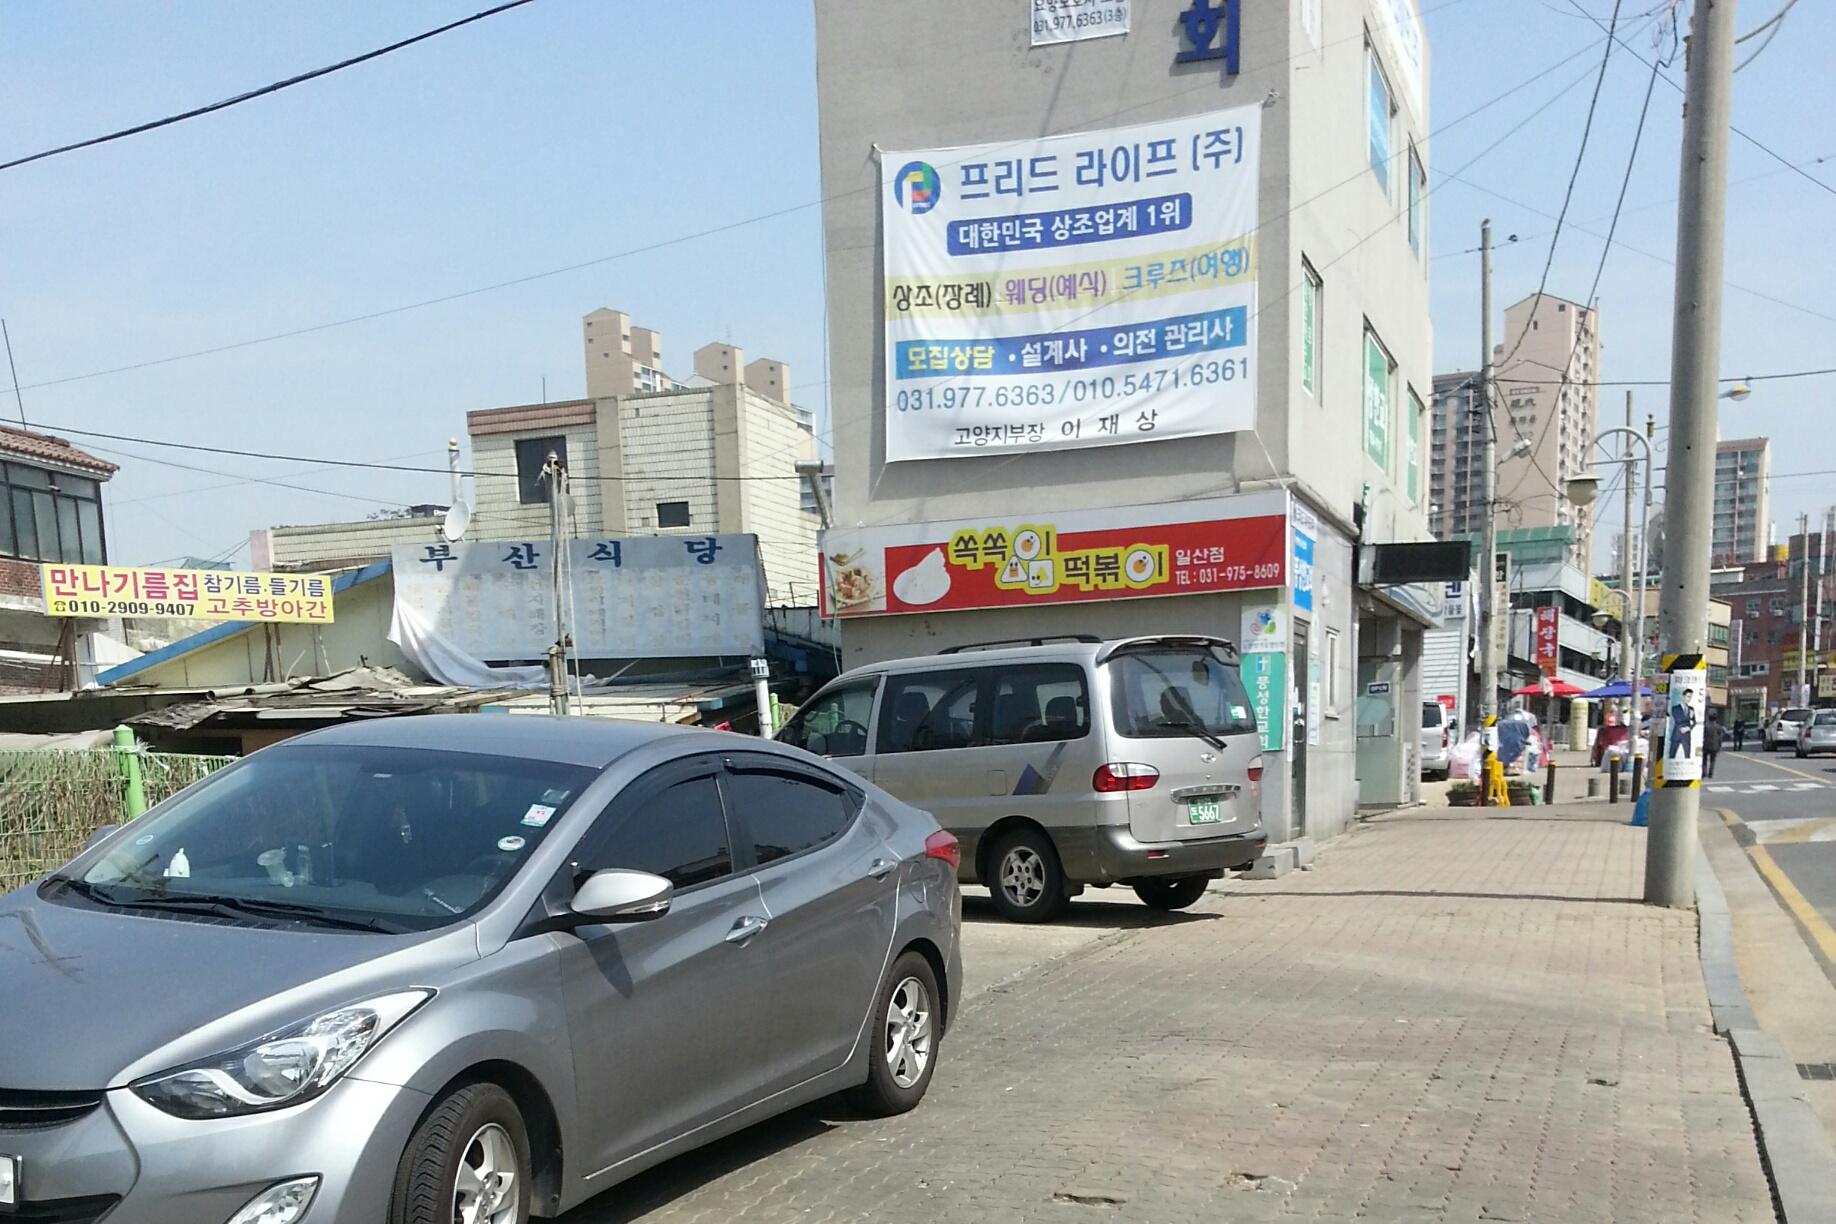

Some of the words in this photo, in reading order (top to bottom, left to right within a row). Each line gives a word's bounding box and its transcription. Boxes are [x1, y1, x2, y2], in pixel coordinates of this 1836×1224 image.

[1175, 0, 1241, 75] 회
[960, 155, 1059, 200] 프리드
[1076, 138, 1177, 187] 라이프
[959, 219, 1043, 249] 대한민국
[1051, 203, 1137, 241] 상조업계
[1147, 198, 1181, 228] 1위
[893, 281, 992, 312] 상조(장례)
[1004, 270, 1107, 306] 웨딩(예식)
[907, 346, 995, 371] 모집상담
[1164, 317, 1234, 350] 관리사
[954, 422, 1046, 447] 고양지부장
[1064, 550, 1165, 585] 떡볶이
[1176, 548, 1226, 565] 일산점
[1199, 563, 1280, 584] 031-975-8609
[50, 568, 199, 600] 만나기름집
[69, 600, 196, 616] 010-2909-9407
[206, 598, 327, 619] 고추방아간
[1199, 805, 1220, 820] 5667
